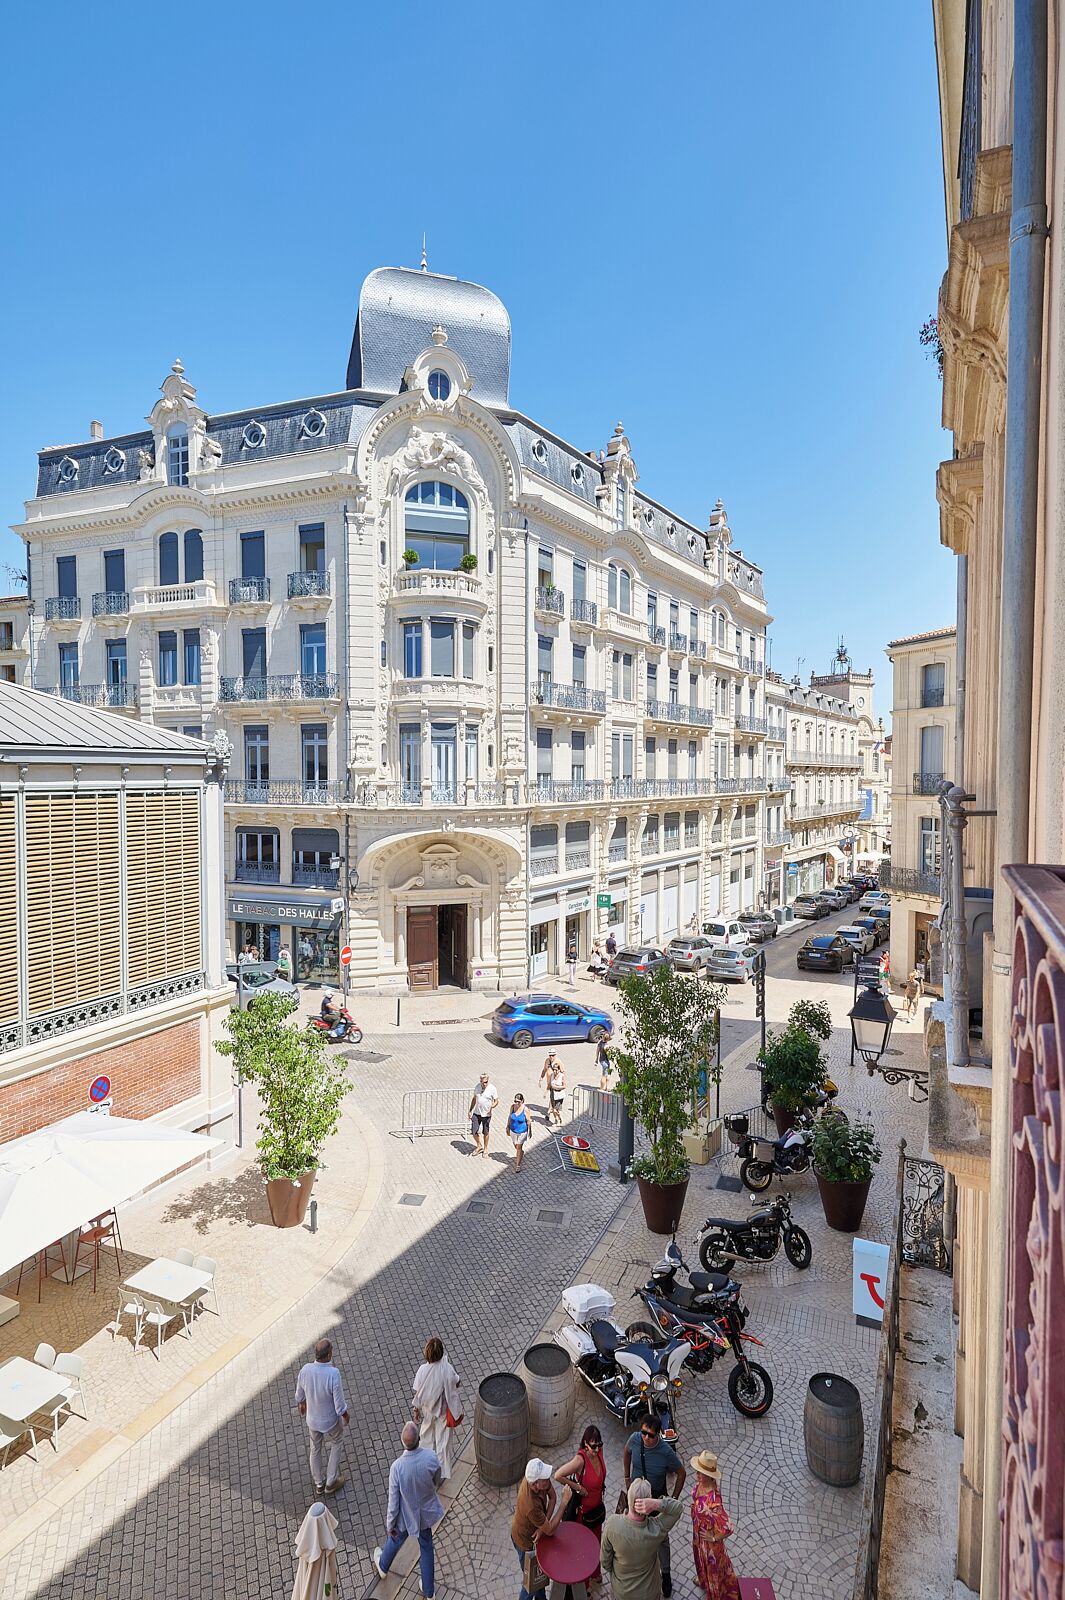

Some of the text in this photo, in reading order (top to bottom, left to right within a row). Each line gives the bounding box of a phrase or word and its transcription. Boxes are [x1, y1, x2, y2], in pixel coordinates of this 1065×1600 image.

[233, 904, 335, 920] LE TABAC DES HALLES
